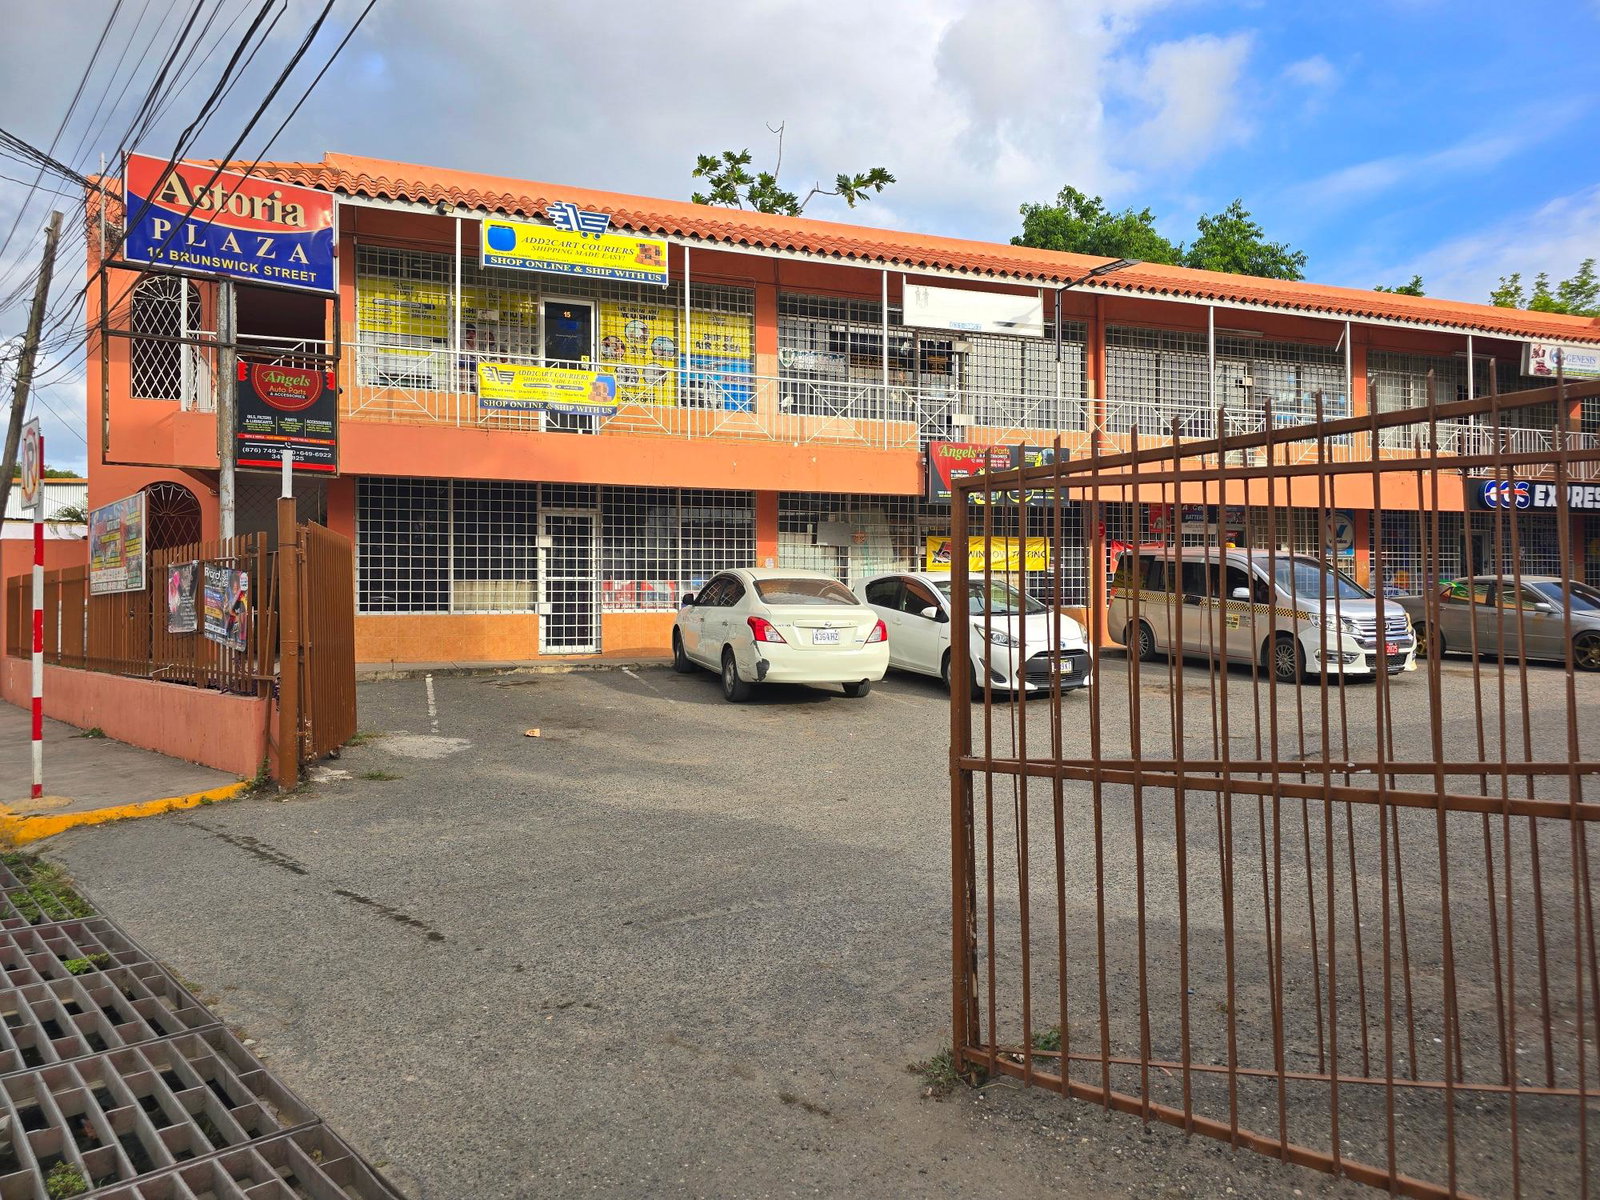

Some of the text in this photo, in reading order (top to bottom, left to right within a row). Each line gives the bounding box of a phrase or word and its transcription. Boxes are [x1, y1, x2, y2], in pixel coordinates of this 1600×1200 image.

[157, 171, 306, 228] Astoria
[152, 218, 309, 265] PLAZA
[521, 236, 635, 256] ADD2CART COURIERS
[531, 245, 573, 255] SHIPPING
[574, 250, 599, 259] MADE
[601, 252, 626, 262] EASY!
[169, 250, 258, 273] BRUNSWICK
[264, 265, 317, 283] STREET
[490, 255, 522, 266] SHOP
[525, 260, 571, 272] ONLINE
[574, 265, 583, 274] &
[586, 267, 612, 277] SHIP
[614, 269, 645, 280] WITH
[648, 273, 662, 282] US
[1566, 353, 1596, 364] GENESIS
[263, 371, 311, 387] Angels
[269, 385, 307, 396] Auto Parts
[483, 399, 508, 408] SHOP
[510, 401, 544, 410] ONLINE
[554, 404, 575, 412] SHIP
[576, 405, 600, 414] WITH
[601, 406, 613, 414] US
[939, 444, 977, 460] Angels
[1533, 484, 1600, 509] EXRES
